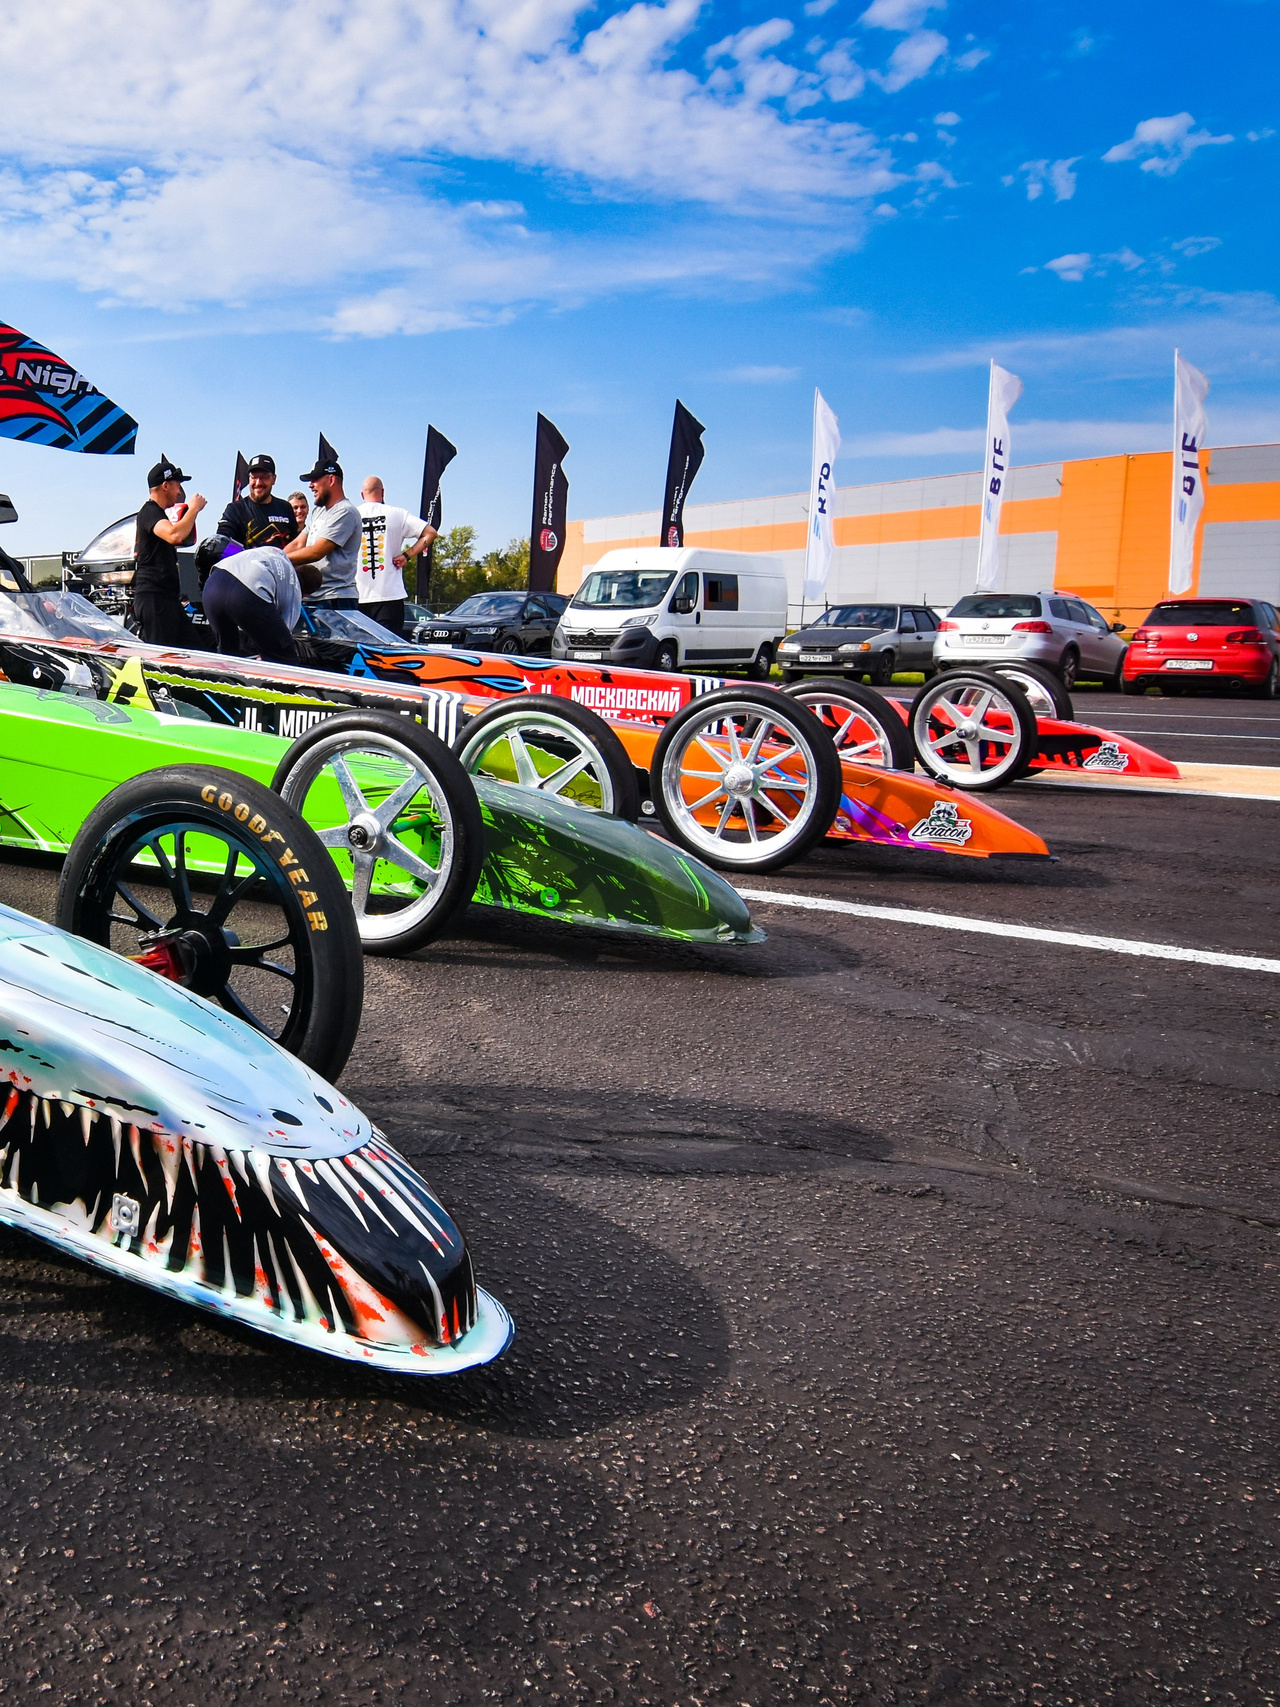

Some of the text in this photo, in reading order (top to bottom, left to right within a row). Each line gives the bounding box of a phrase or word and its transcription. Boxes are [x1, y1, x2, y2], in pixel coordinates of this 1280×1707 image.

[17, 362, 94, 395] Nigh
[548, 463, 558, 526] Performance
[571, 685, 681, 712] МОСКОВСКИЙ
